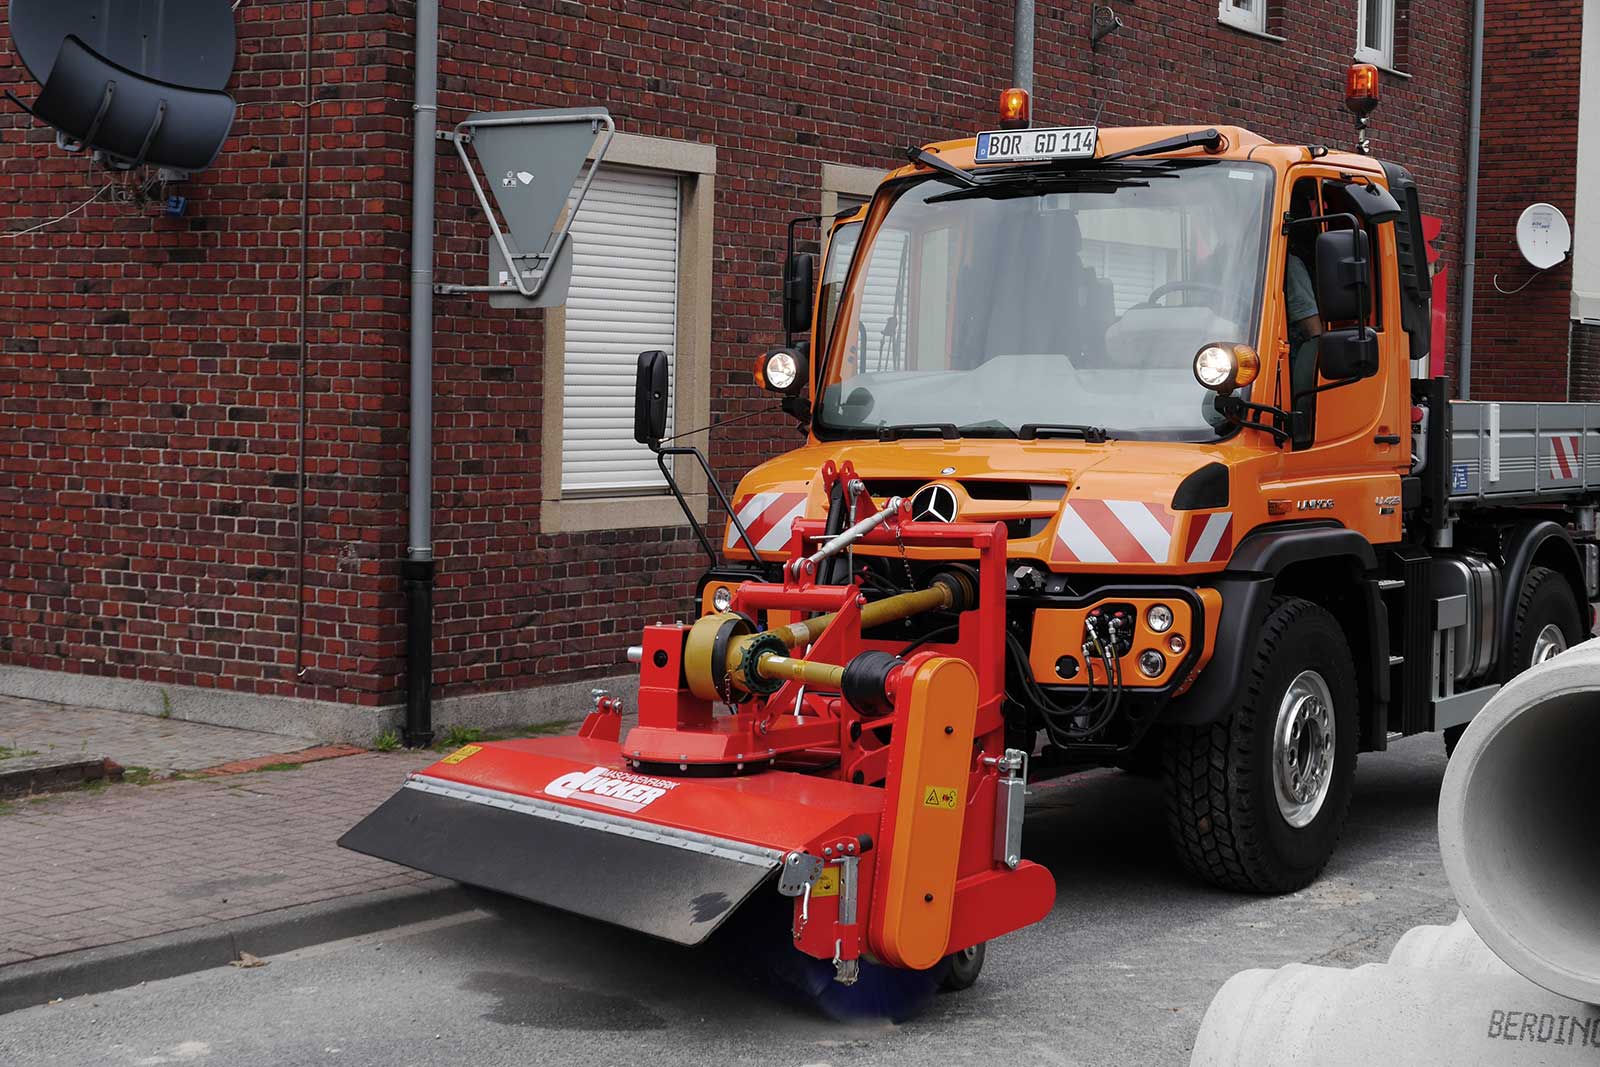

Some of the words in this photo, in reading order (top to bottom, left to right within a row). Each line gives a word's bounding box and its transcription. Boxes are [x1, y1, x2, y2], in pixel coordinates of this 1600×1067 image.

[989, 135, 1022, 156] BOR
[1035, 133, 1057, 153] GD
[1060, 131, 1092, 152] 114
[602, 769, 681, 790] MASCHINENFABRIK
